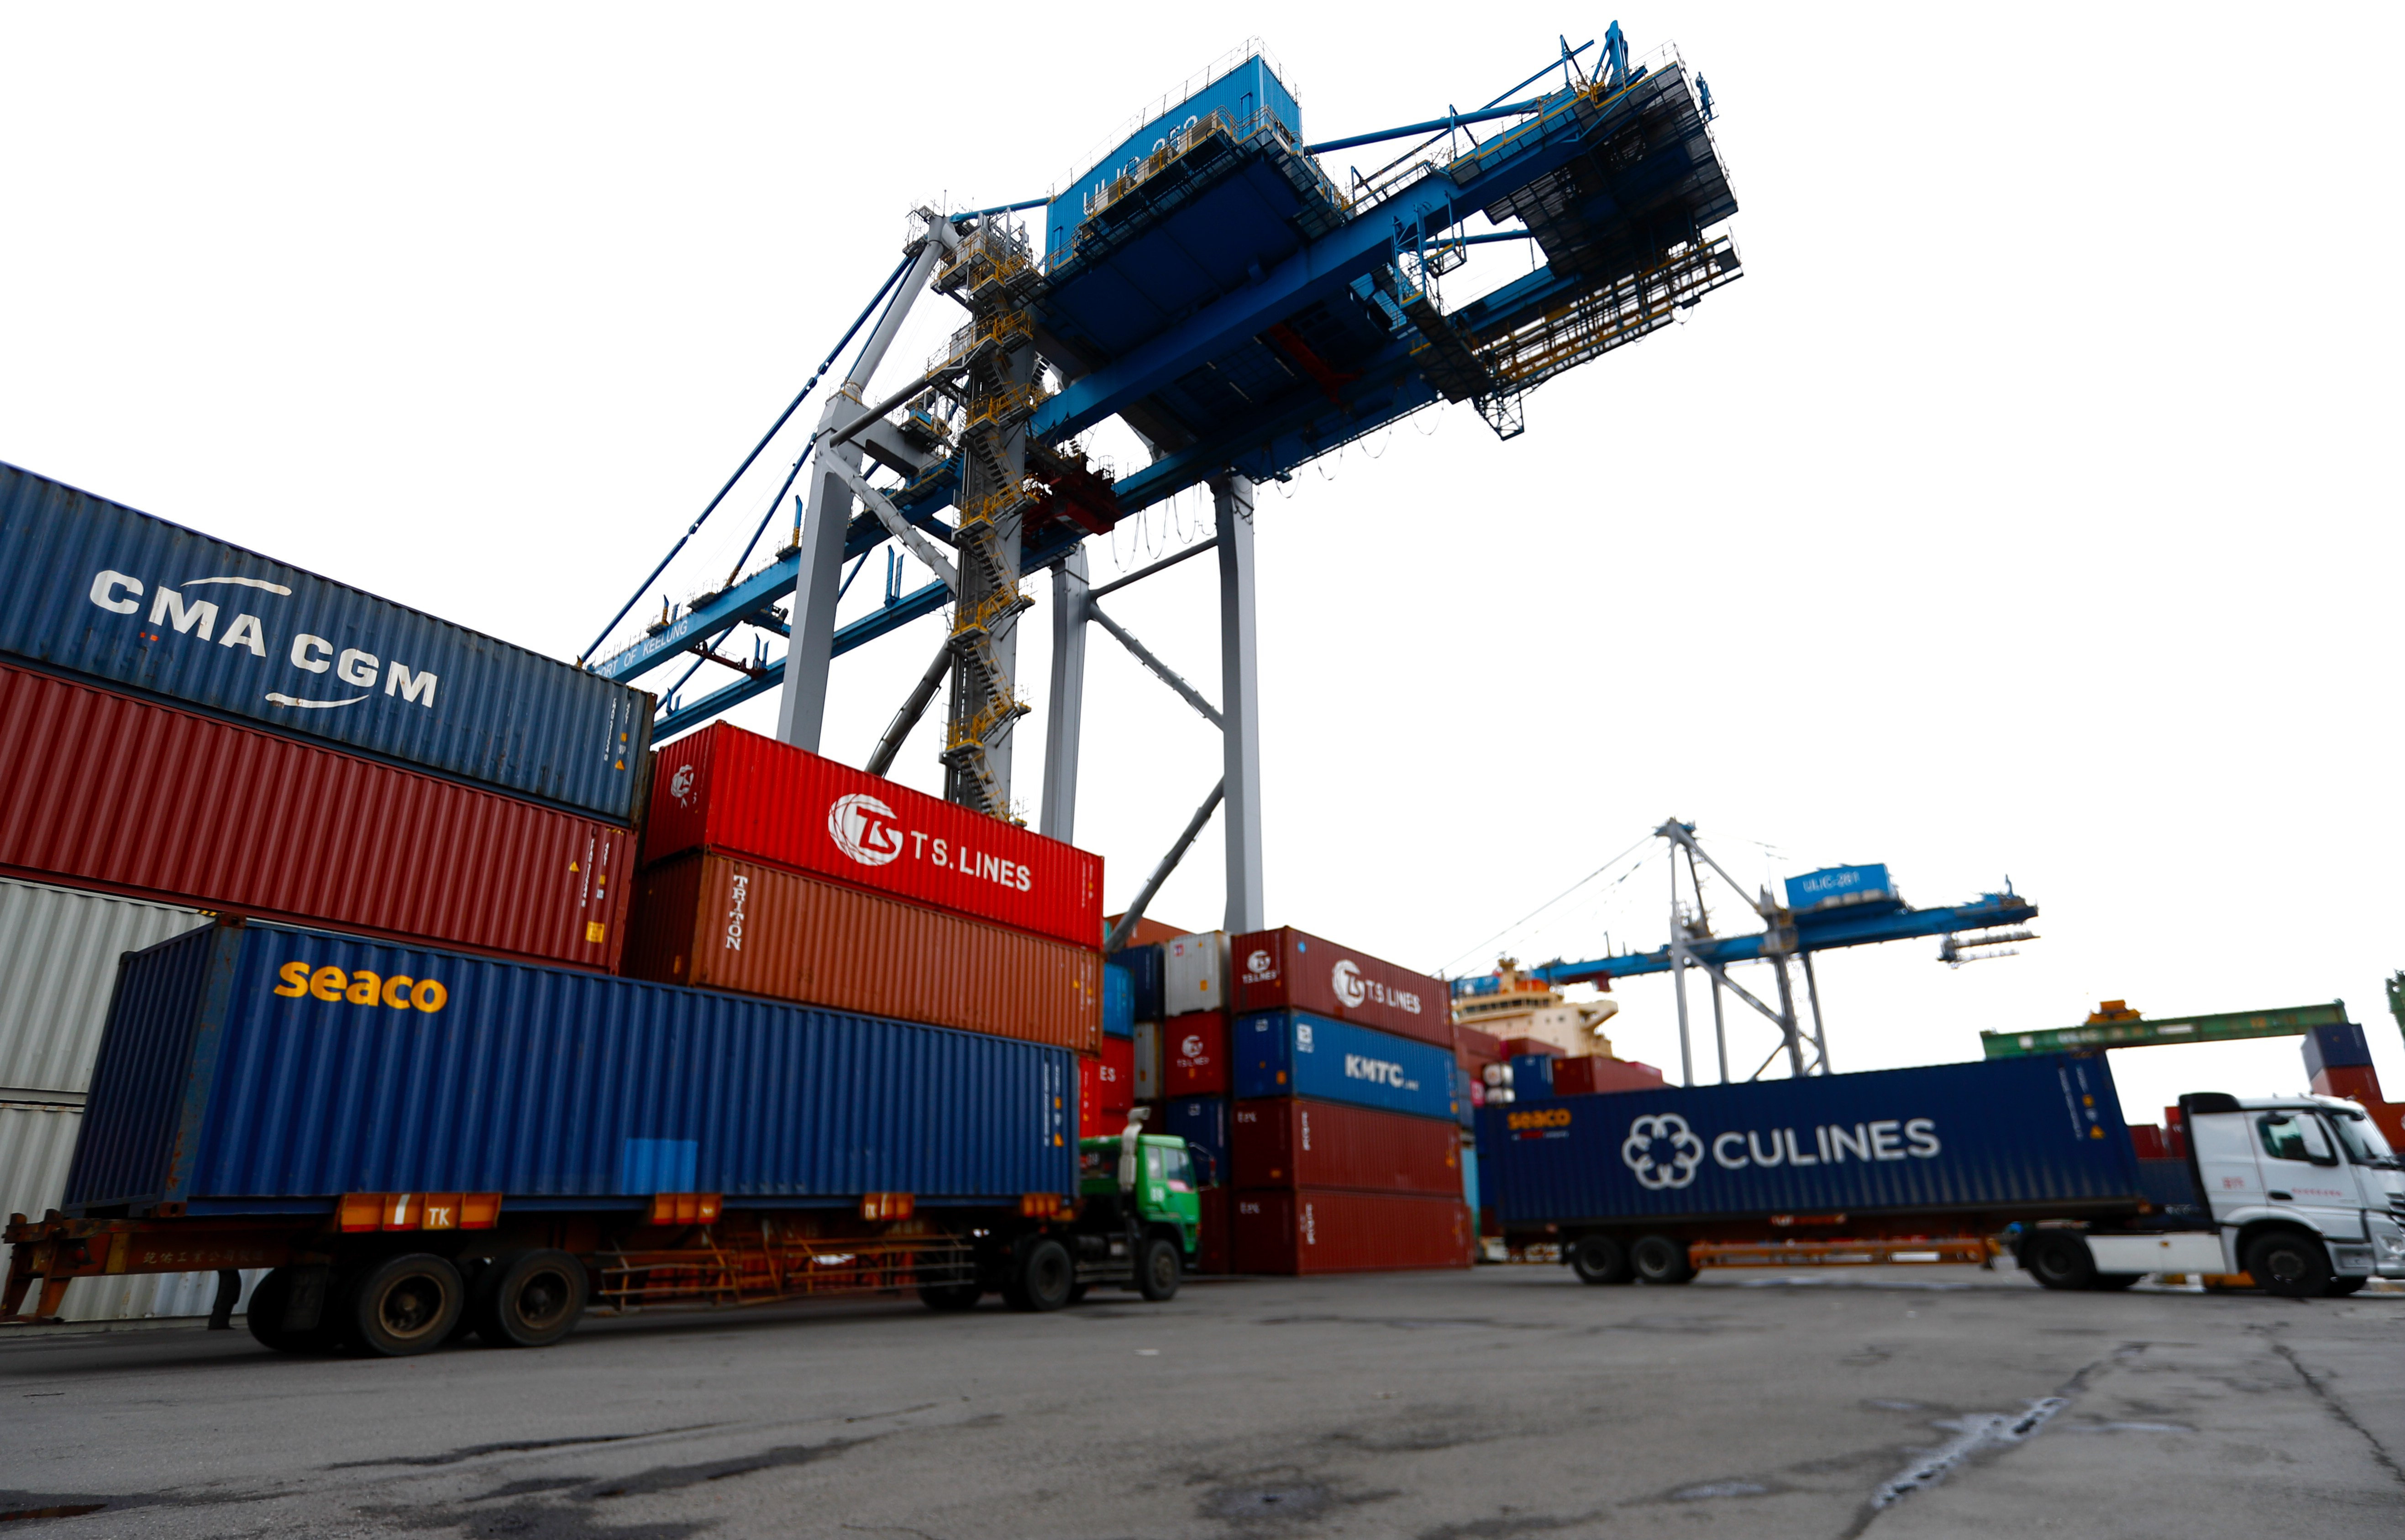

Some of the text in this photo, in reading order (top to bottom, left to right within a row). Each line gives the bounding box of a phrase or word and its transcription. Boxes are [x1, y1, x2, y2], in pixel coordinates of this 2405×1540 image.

[89, 569, 438, 708] CMA CGM
[624, 648, 637, 667] OF
[642, 620, 688, 657] KEELUNG
[725, 875, 748, 951] TRITON
[273, 961, 448, 1014] seaco
[1345, 1054, 1404, 1089] KMTC
[1507, 1108, 1572, 1130] seaco
[1712, 1117, 1942, 1169] CULINES
[429, 1207, 450, 1226] TK
